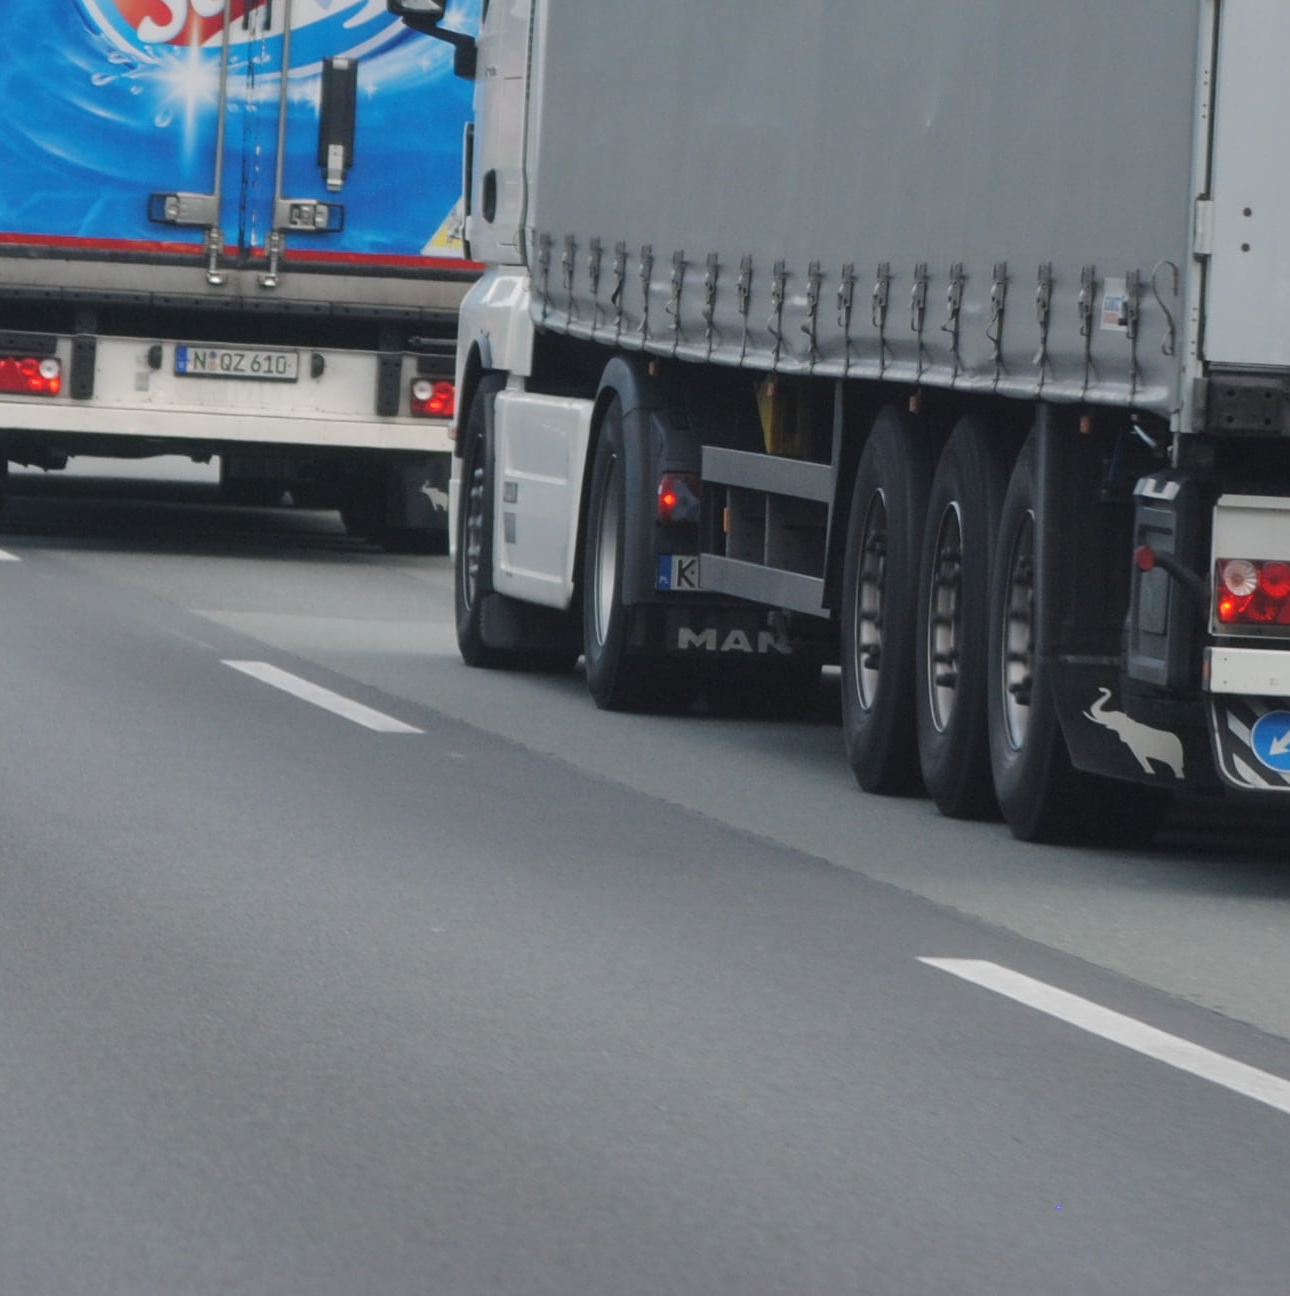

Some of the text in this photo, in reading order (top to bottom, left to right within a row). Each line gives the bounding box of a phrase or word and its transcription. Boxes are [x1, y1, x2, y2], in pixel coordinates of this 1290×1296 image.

[193, 351, 287, 375] N QZ 610
[677, 627, 793, 655] MAN
